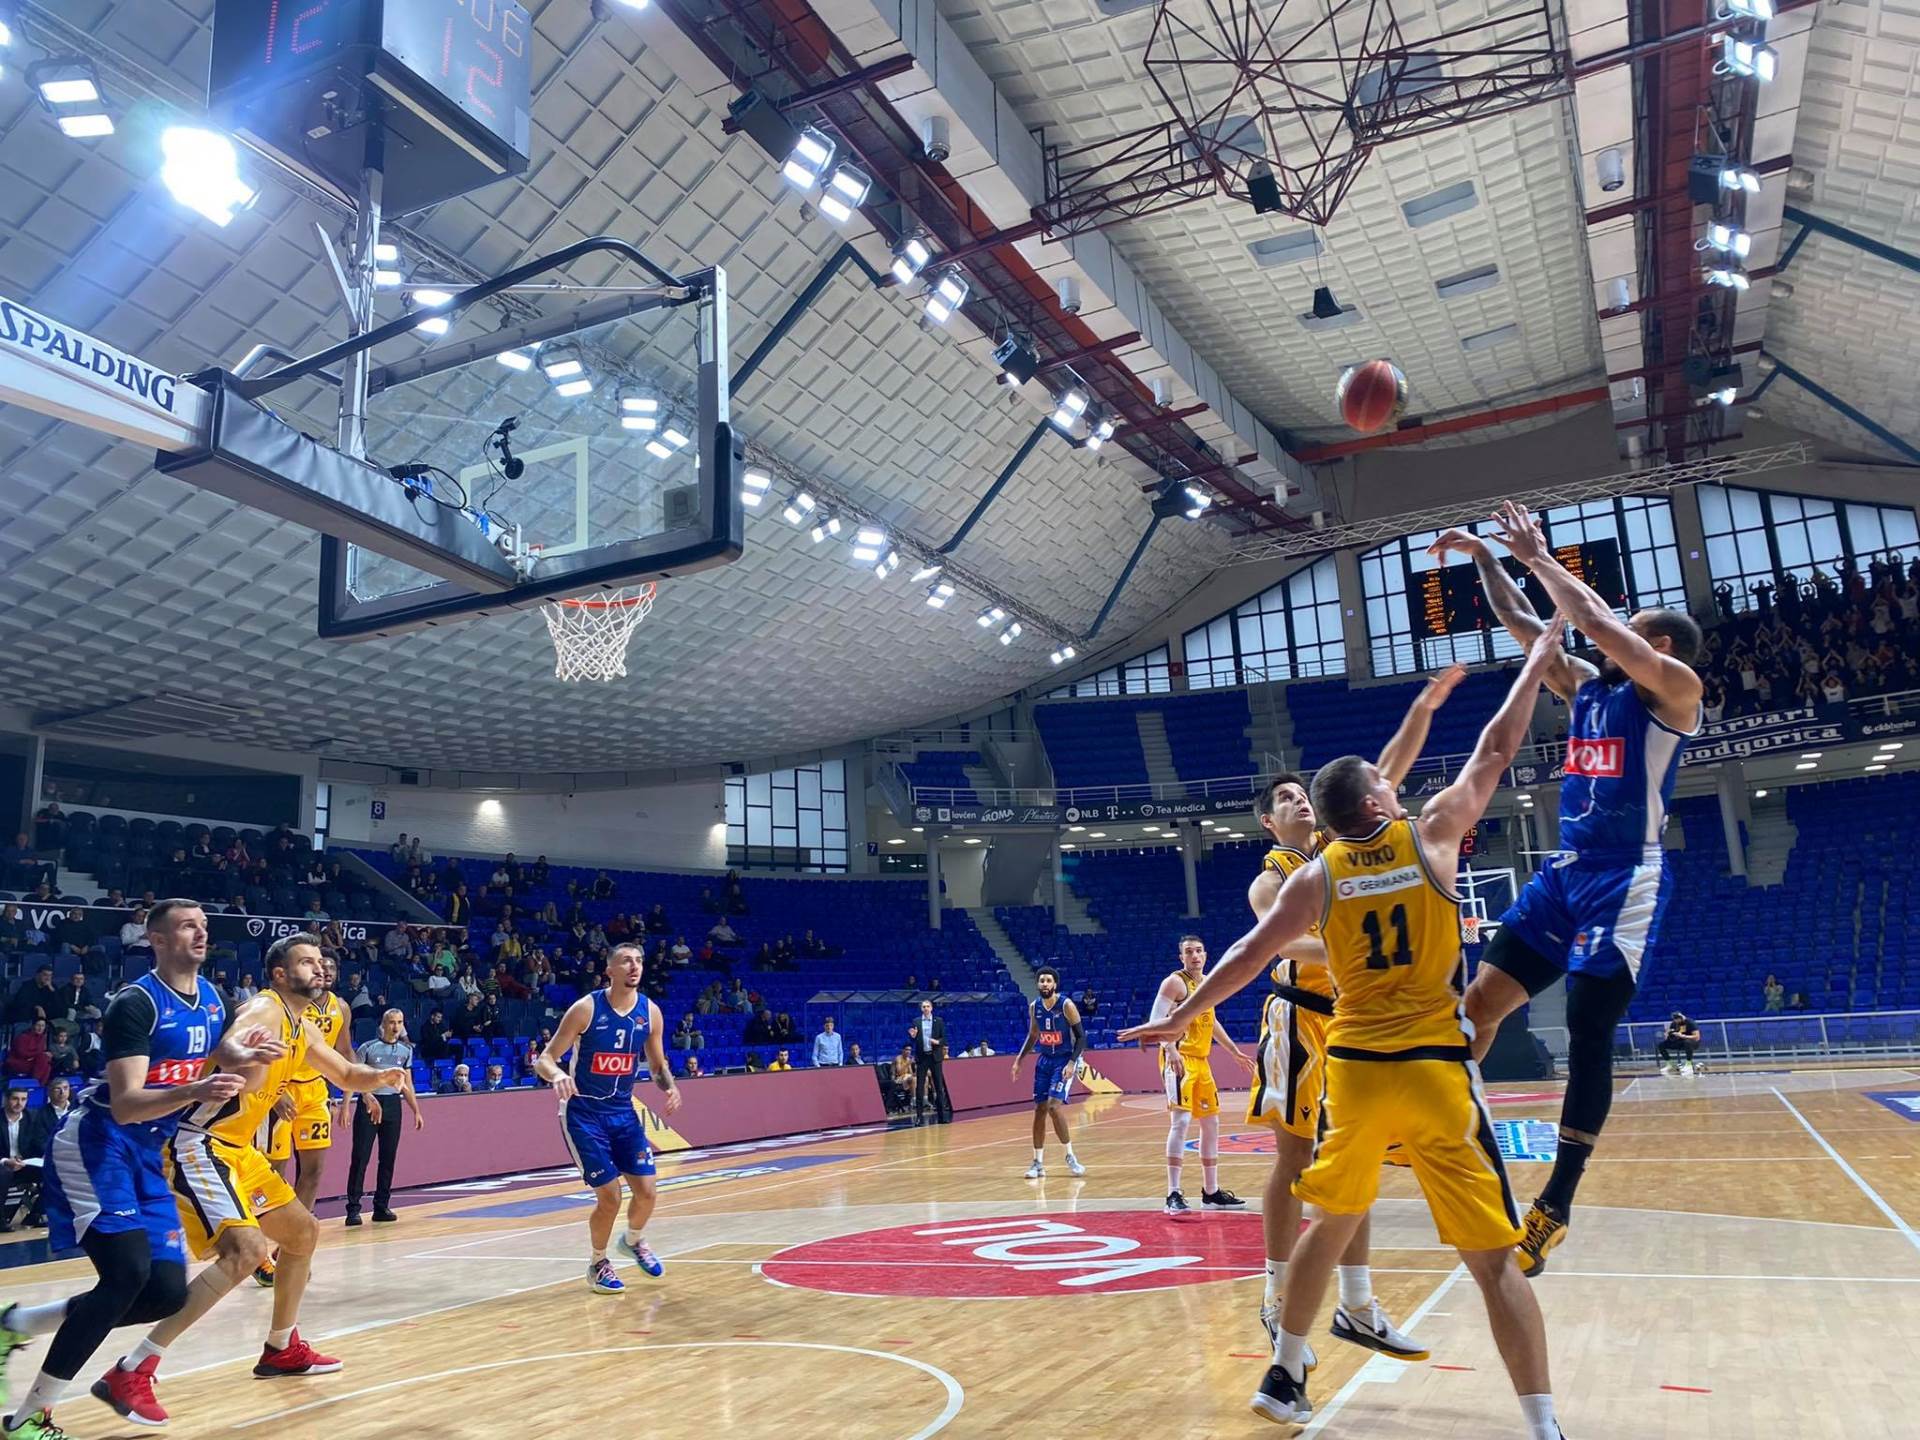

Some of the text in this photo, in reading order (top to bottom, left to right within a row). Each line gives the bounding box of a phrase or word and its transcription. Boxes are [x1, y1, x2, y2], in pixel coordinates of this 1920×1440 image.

[0, 302, 176, 412] SPALDING
[375, 802, 382, 815] 8
[981, 809, 1014, 822] AROMA
[1081, 809, 1099, 818] NLB
[1156, 804, 1206, 814] Tea Medica
[1347, 844, 1396, 867] VUKO
[1359, 871, 1420, 891] GERMANIA
[1362, 903, 1412, 969] 11
[186, 1026, 206, 1054] 19
[614, 1029, 626, 1048] 3
[598, 1056, 632, 1072] VOLI
[311, 1123, 330, 1140] 23
[912, 1219, 1204, 1286] VOLI
